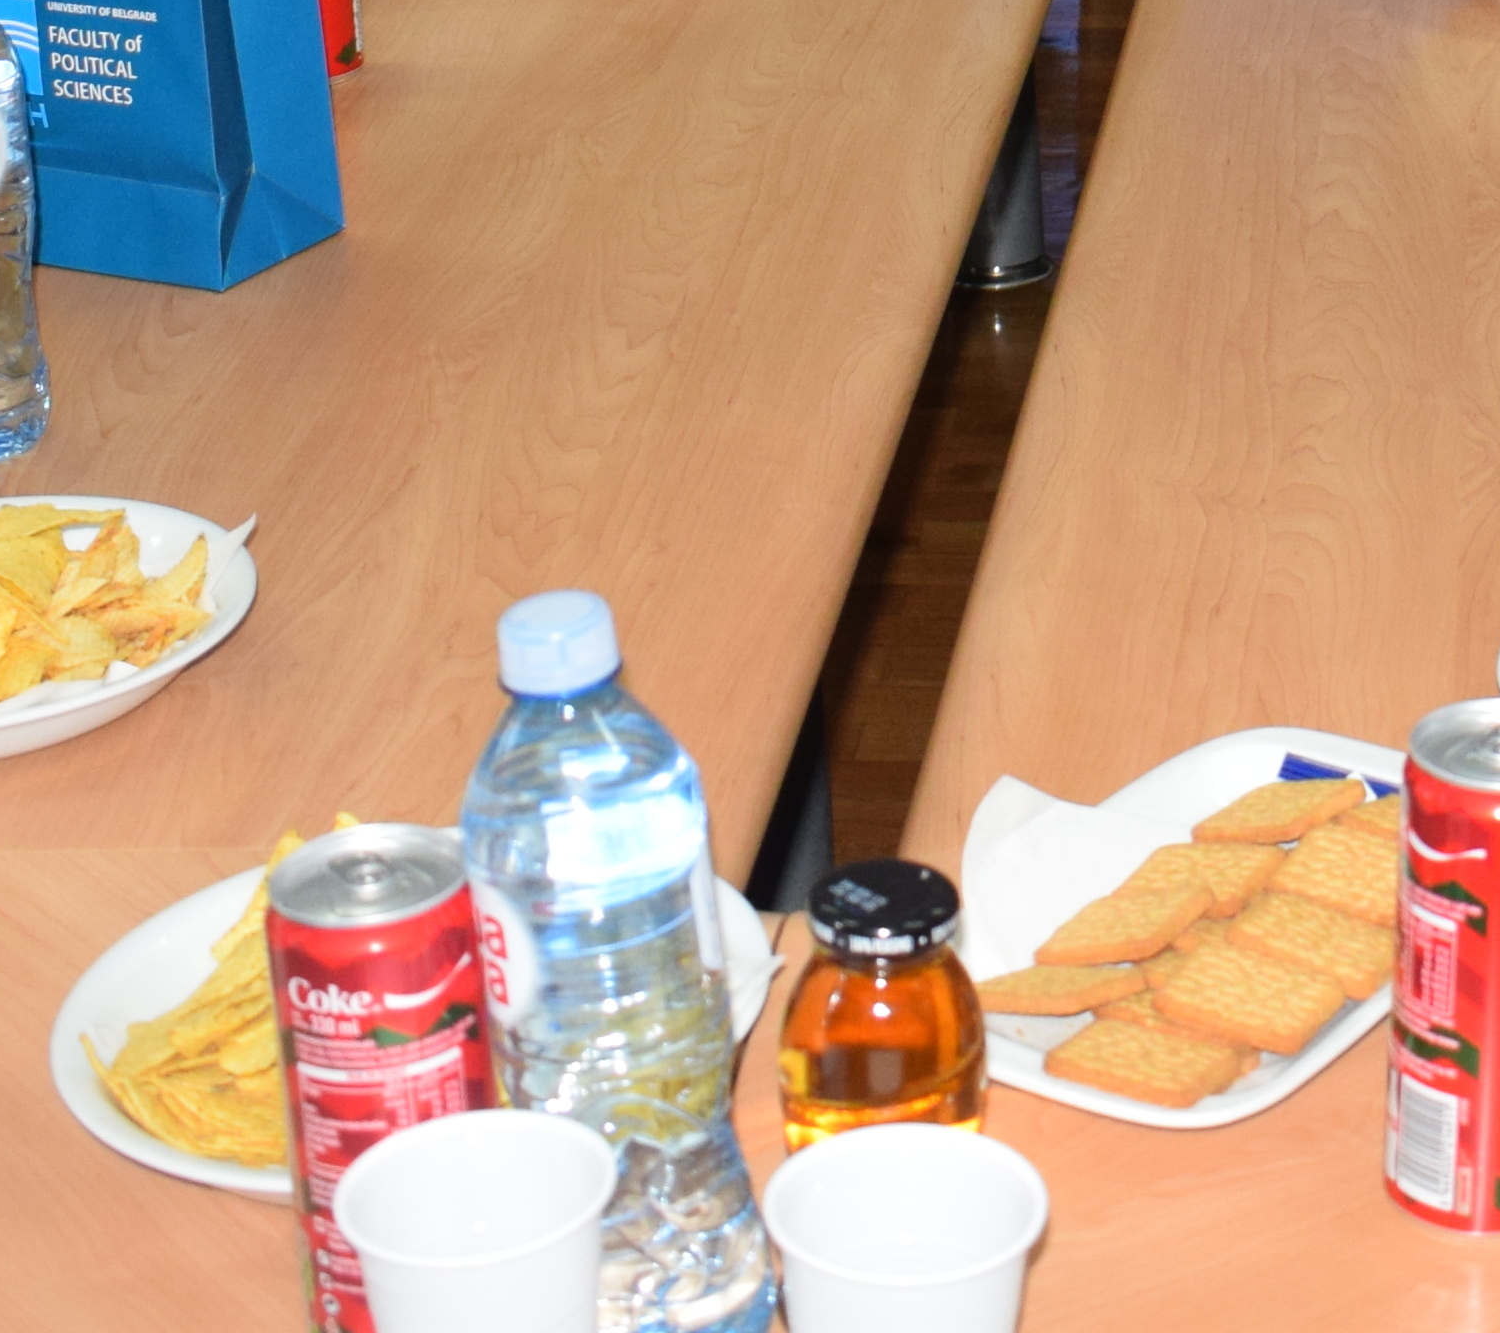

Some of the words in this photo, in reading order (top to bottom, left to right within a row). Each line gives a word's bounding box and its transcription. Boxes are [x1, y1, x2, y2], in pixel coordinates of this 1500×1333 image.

[47, 1, 98, 17] UNIVERSITY
[98, 7, 111, 17] OF
[112, 8, 157, 23] BELGRADE
[49, 25, 120, 52] FACULTY
[125, 35, 143, 53] of
[51, 52, 138, 80] POLITICAL
[54, 79, 133, 105] SCIENCES
[288, 976, 373, 1016] Coke
